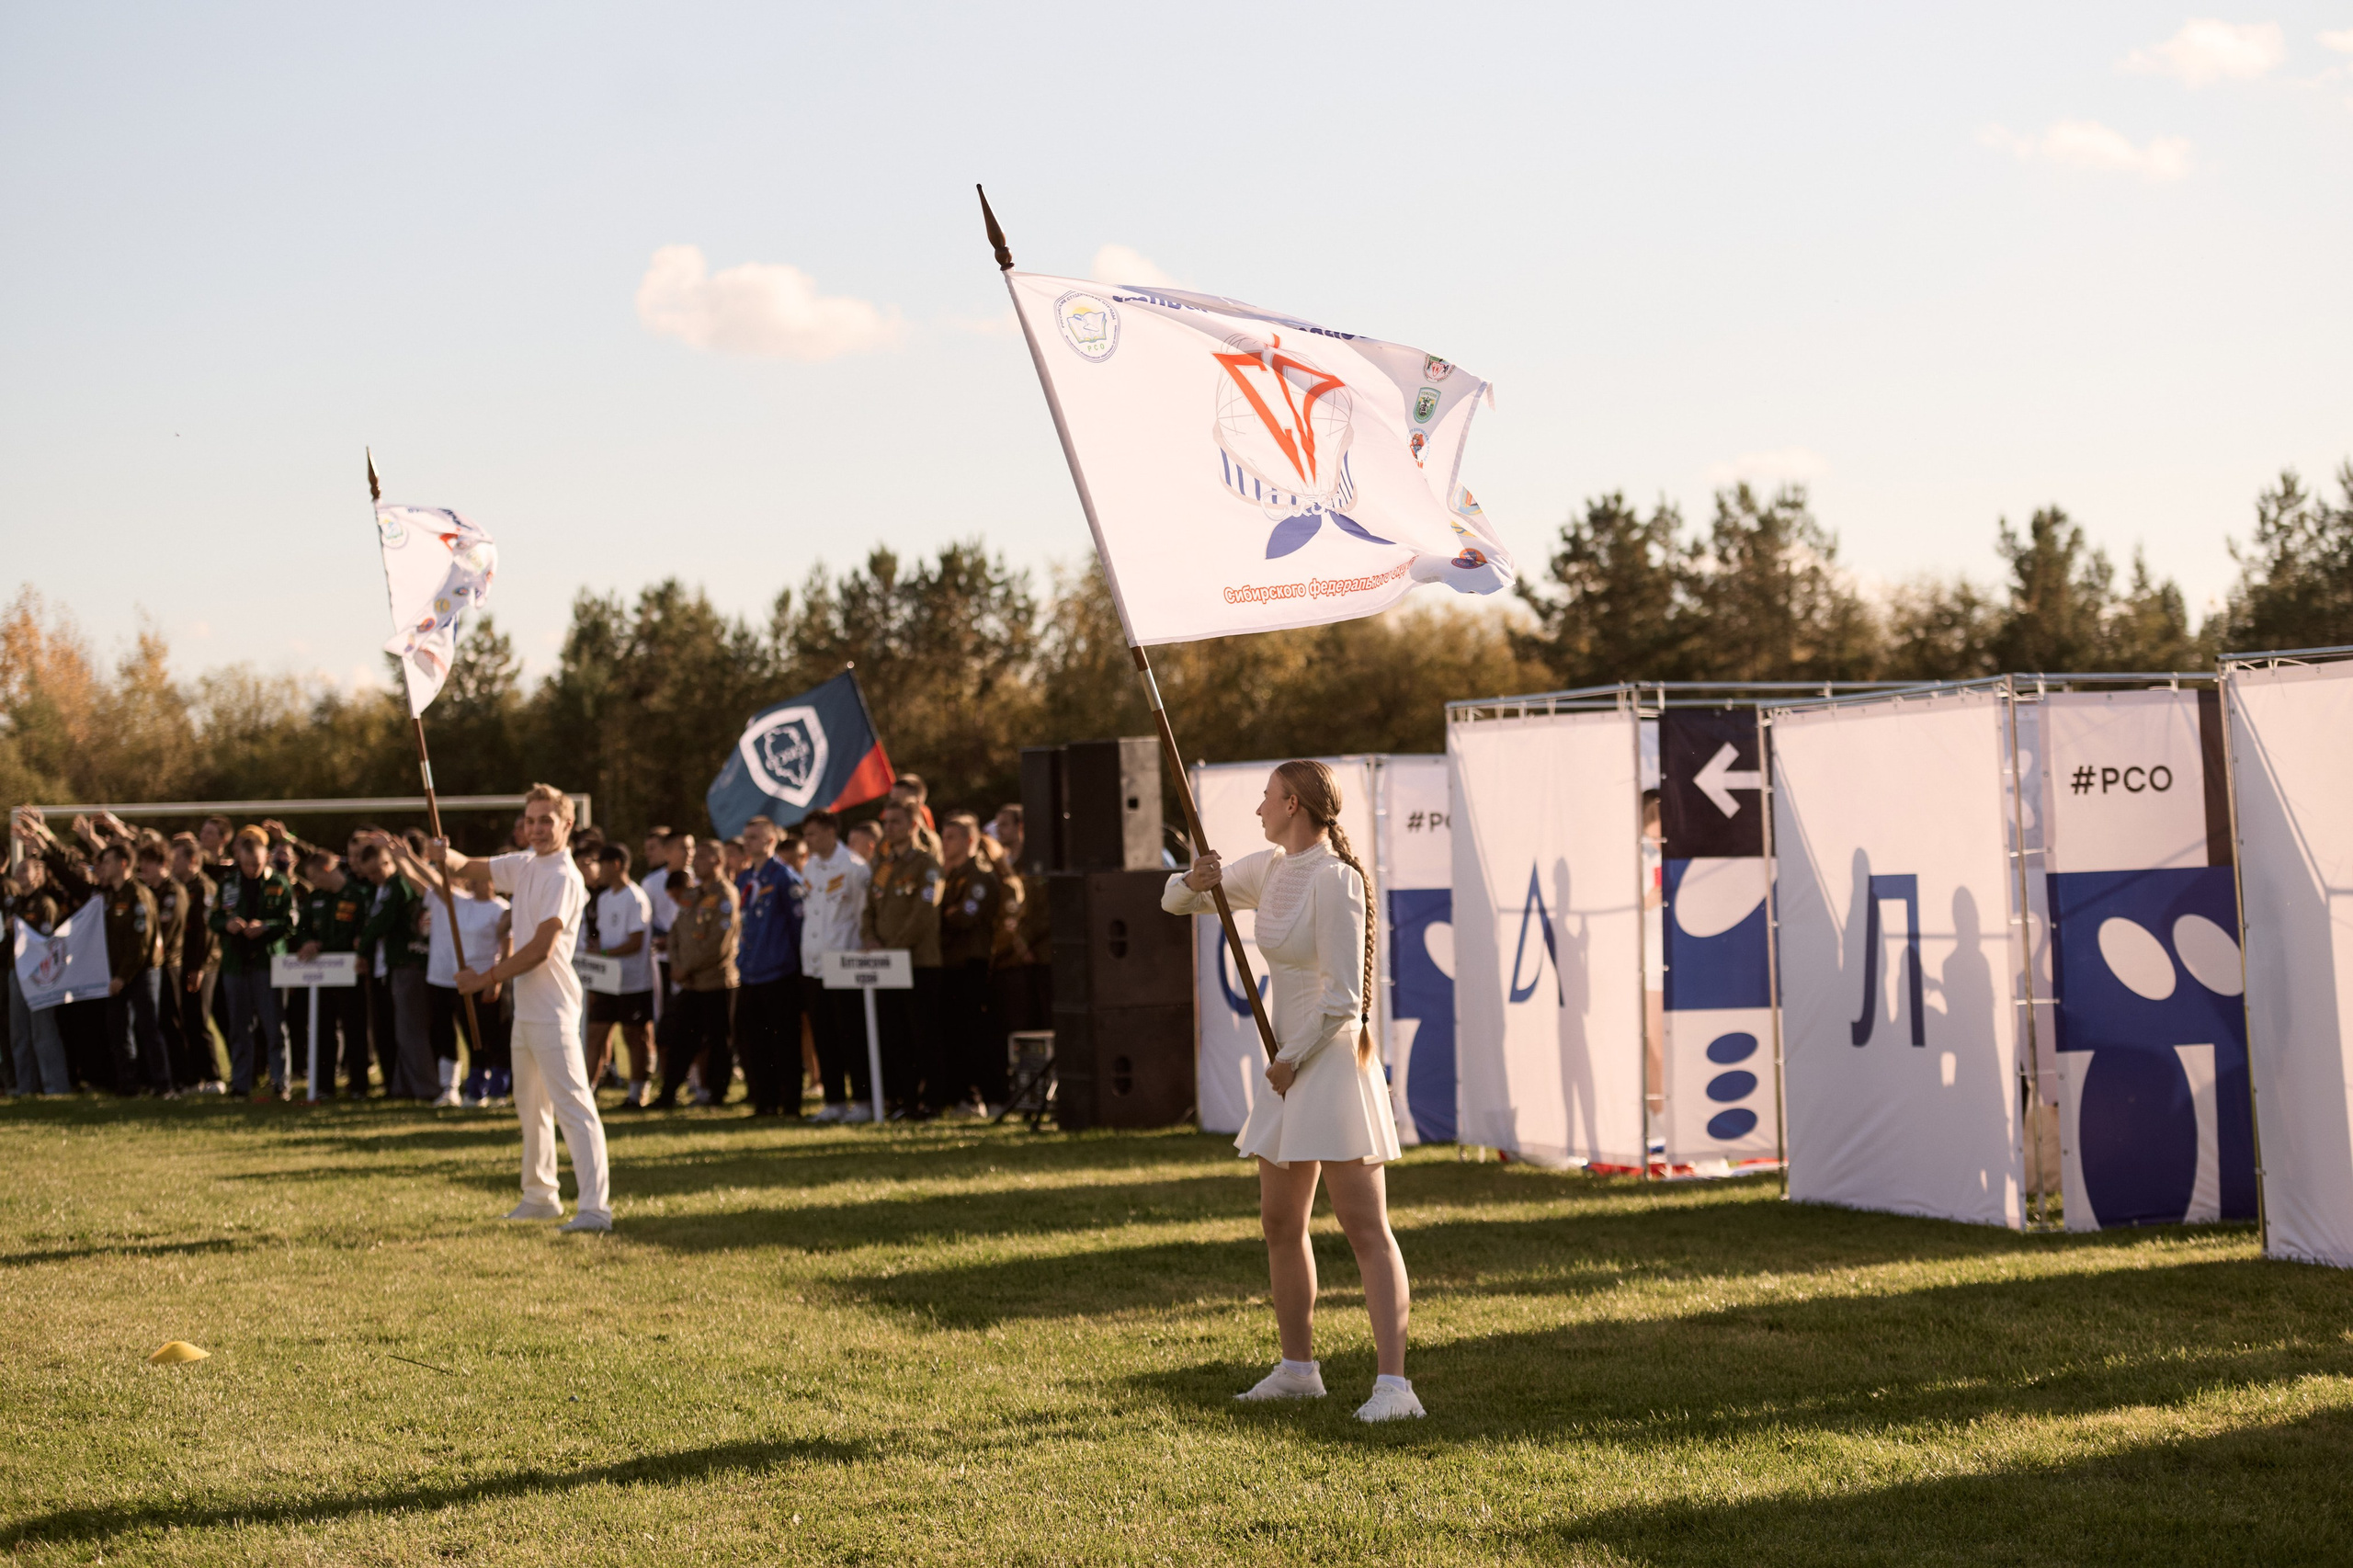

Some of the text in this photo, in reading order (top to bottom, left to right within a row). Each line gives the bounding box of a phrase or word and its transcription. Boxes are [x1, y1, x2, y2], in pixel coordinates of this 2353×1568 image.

[1086, 343, 1106, 352] РСО
[1223, 585, 1305, 605] Сибирского
[1308, 572, 1391, 600] федерального
[2070, 765, 2174, 796] #РСО
